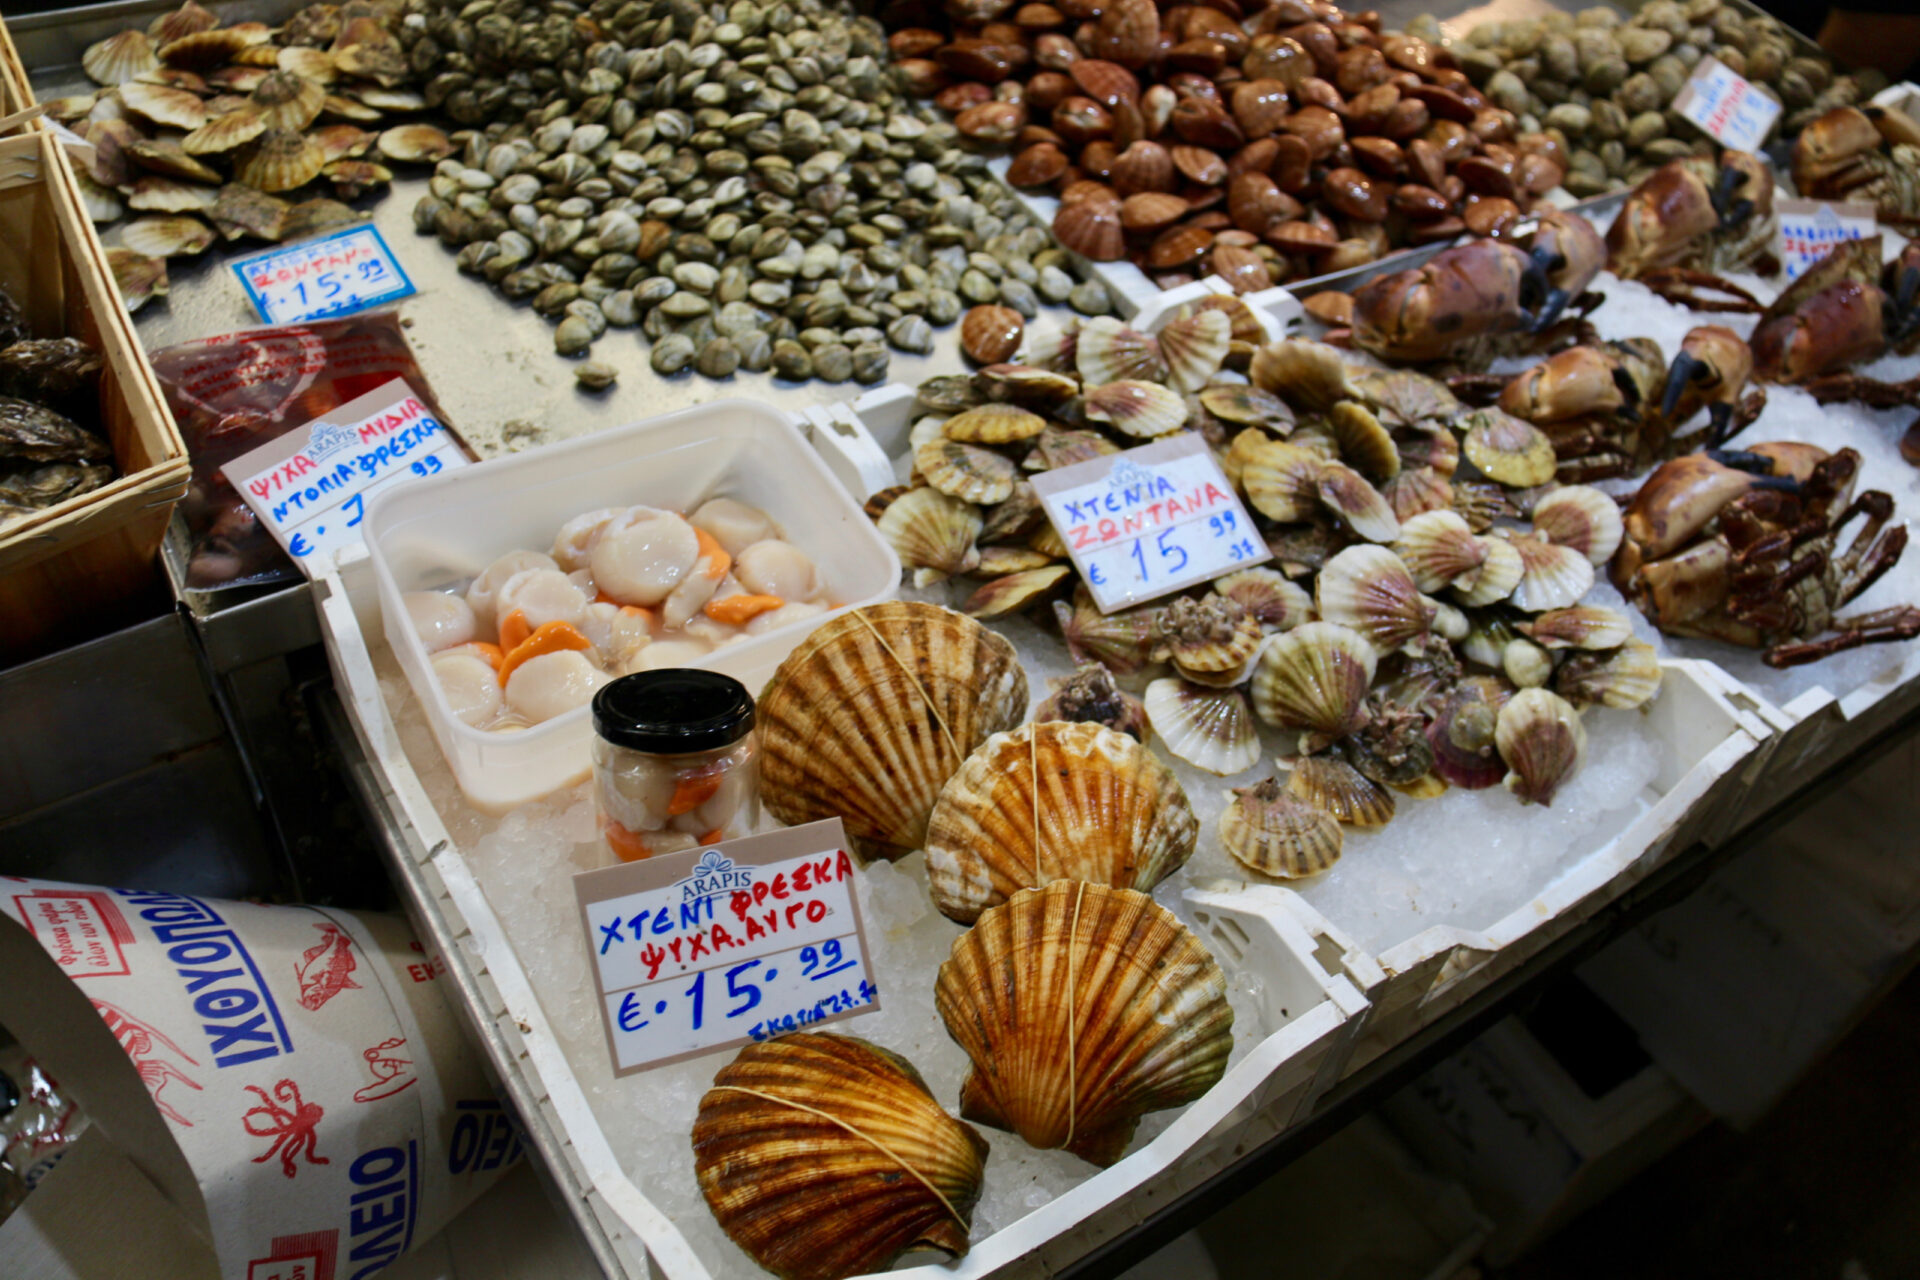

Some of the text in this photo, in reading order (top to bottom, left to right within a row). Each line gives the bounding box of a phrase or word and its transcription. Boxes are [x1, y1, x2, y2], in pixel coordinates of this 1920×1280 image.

[249, 453, 318, 500] ΨΥΧΑ
[357, 396, 427, 444] ΜΥΔΙΑ
[308, 428, 357, 459] ARAPIS
[1063, 475, 1177, 524] ΧΤΕΝΙΑ
[1067, 481, 1231, 550] ΖΩΝΤΑΝΑ
[682, 871, 752, 901] ARAPIS
[729, 849, 854, 923] ΦΡΕΣΚΑ
